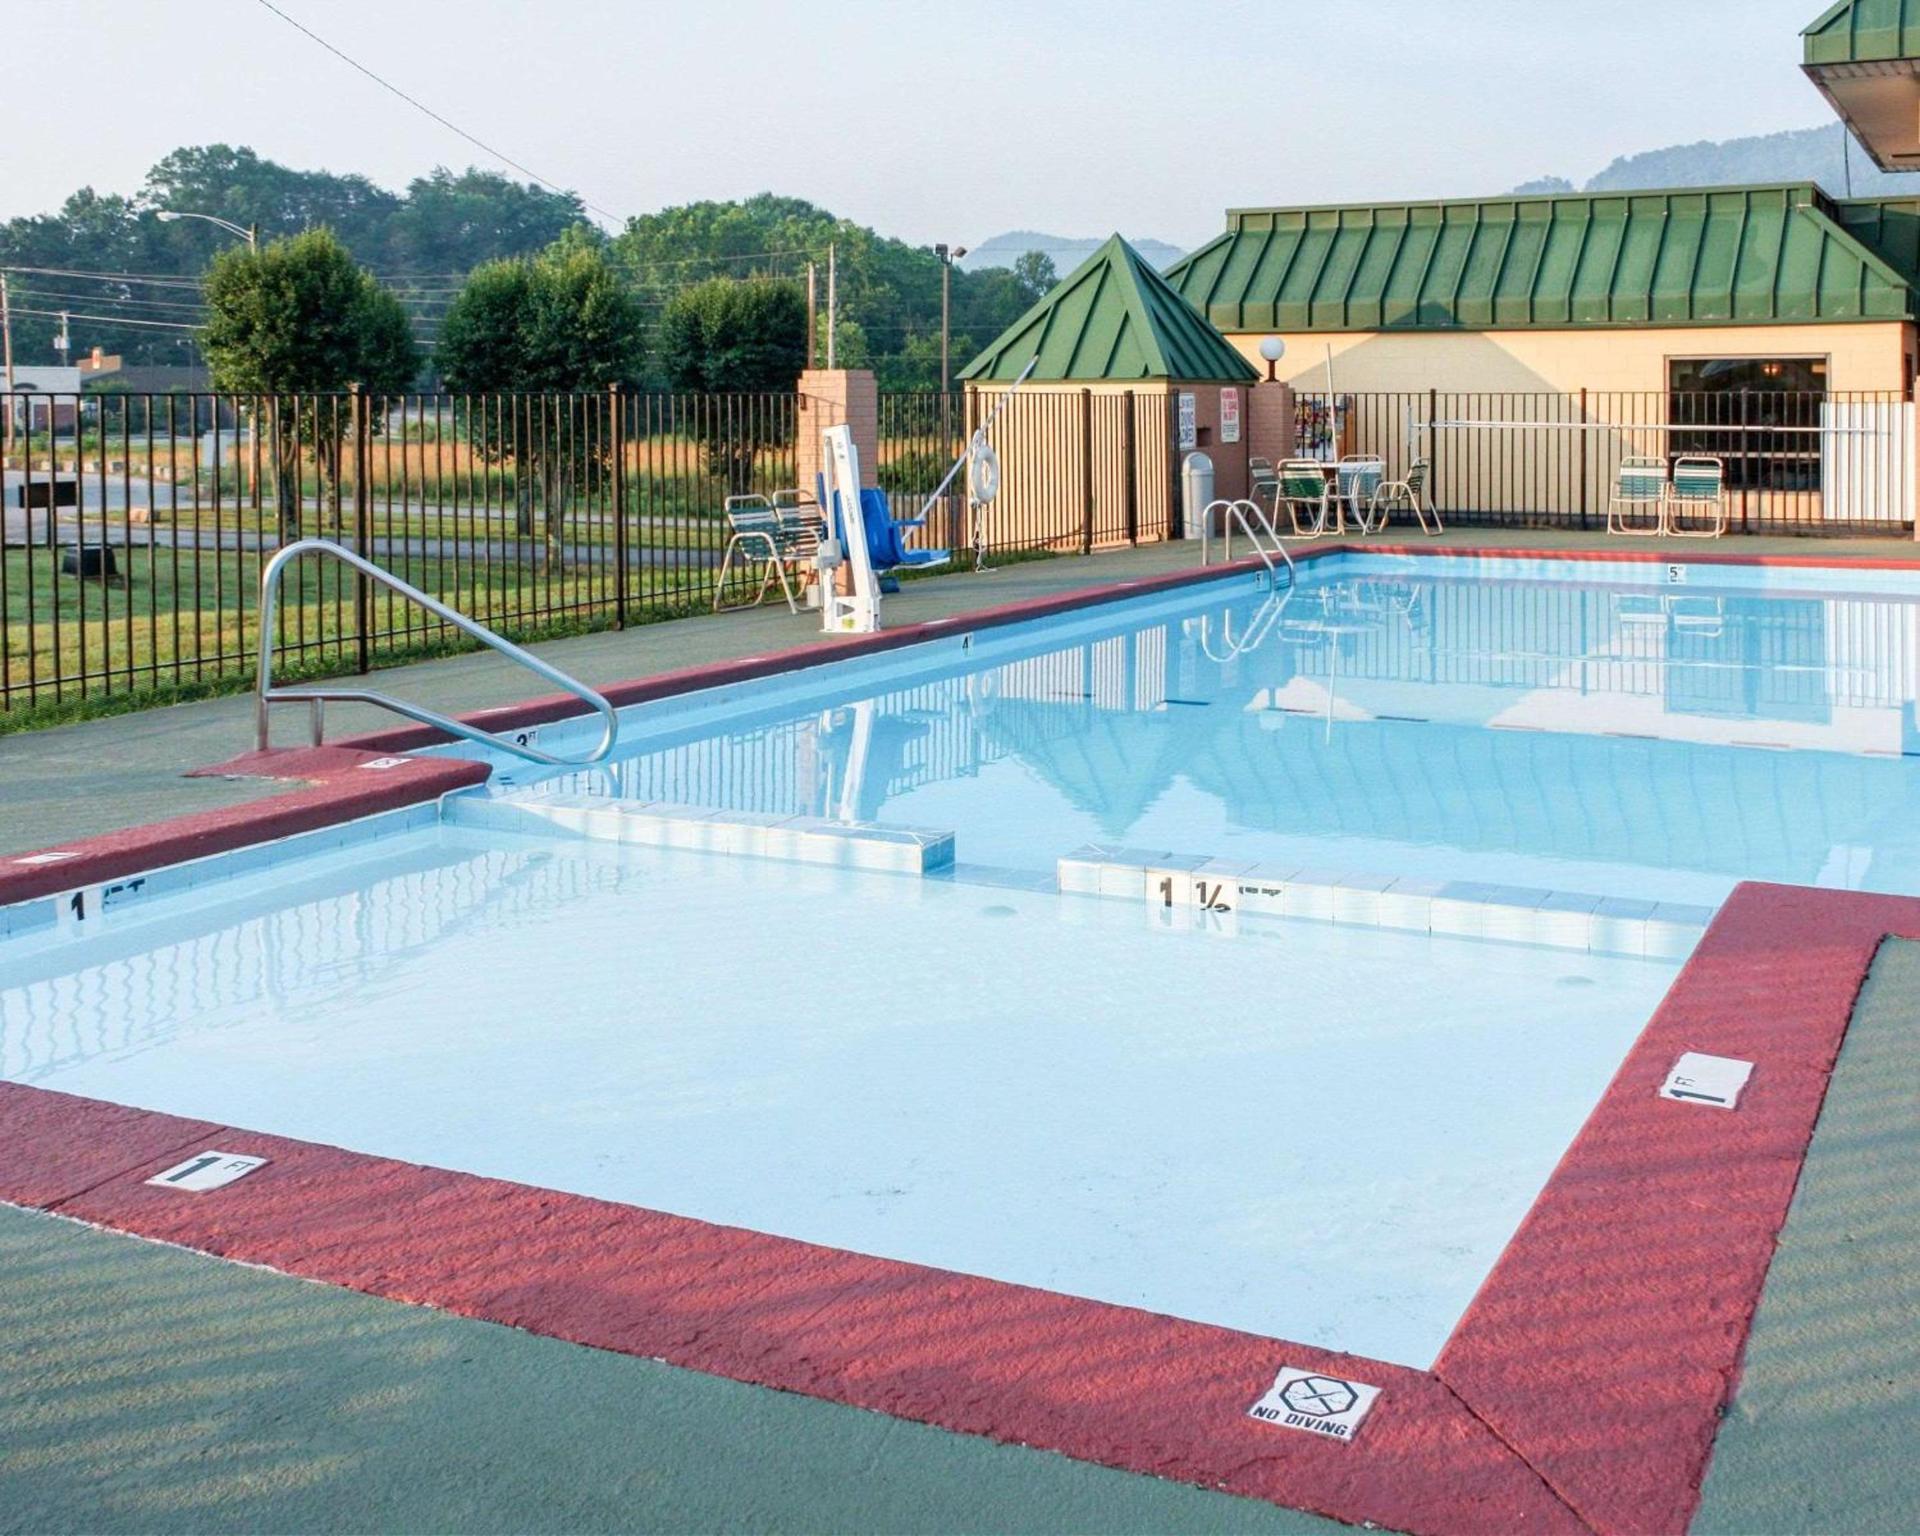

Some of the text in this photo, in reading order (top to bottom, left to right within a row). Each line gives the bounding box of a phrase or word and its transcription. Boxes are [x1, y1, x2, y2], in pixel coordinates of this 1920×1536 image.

[71, 891, 85, 921] 1
[1160, 877, 1172, 907] 1
[1669, 1089, 1726, 1103] 1
[165, 1156, 256, 1182] 1 FT
[1252, 1405, 1349, 1436] NO DIVING
